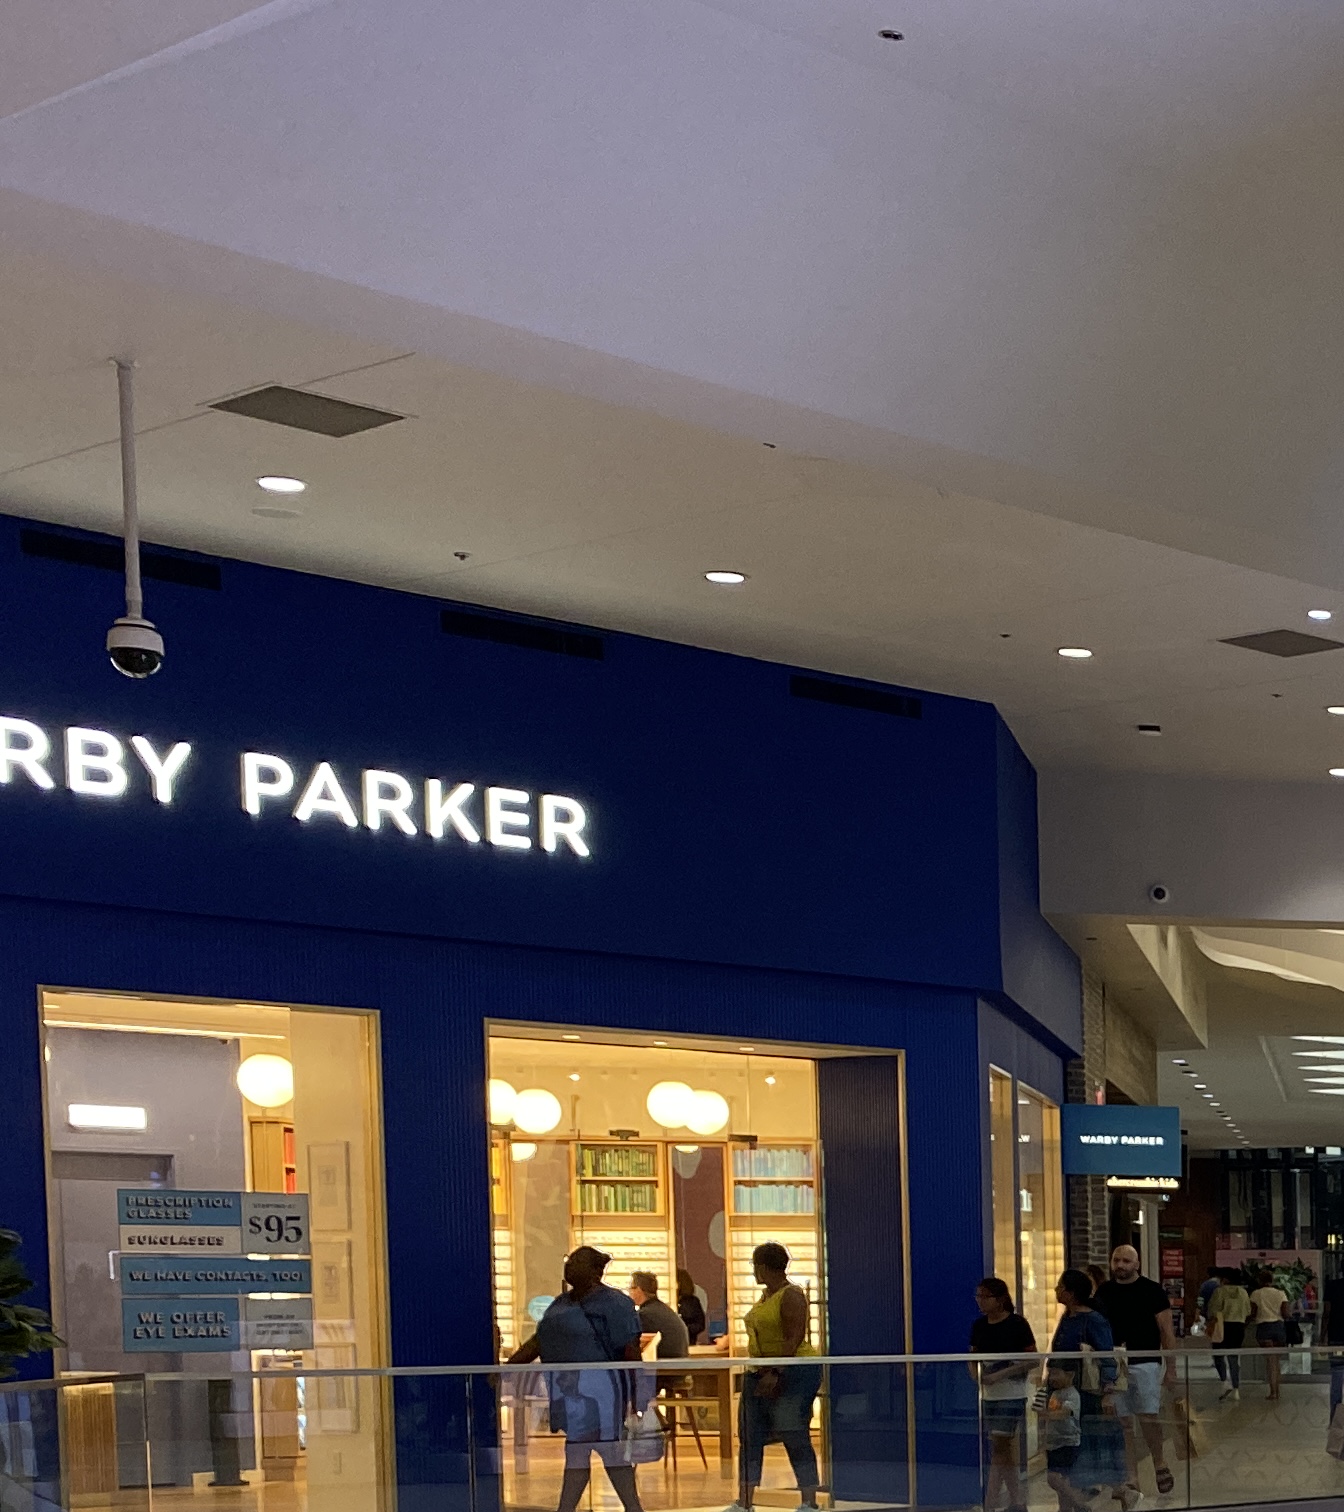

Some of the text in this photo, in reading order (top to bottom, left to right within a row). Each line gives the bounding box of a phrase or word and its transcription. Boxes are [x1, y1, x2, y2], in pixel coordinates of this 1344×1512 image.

[240, 751, 590, 856] PARKER
[1080, 1135, 1164, 1146] WARBY PARKER
[126, 1196, 233, 1209] PRESCRIPTION
[126, 1208, 192, 1219] GLASSES
[248, 1214, 303, 1244] $95
[127, 1235, 225, 1246] SUNGLASSES
[130, 1270, 150, 1281] WE
[155, 1270, 191, 1281] HAVE
[139, 1312, 225, 1325] WE OFFER
[134, 1325, 231, 1339] EYE EXAMS
